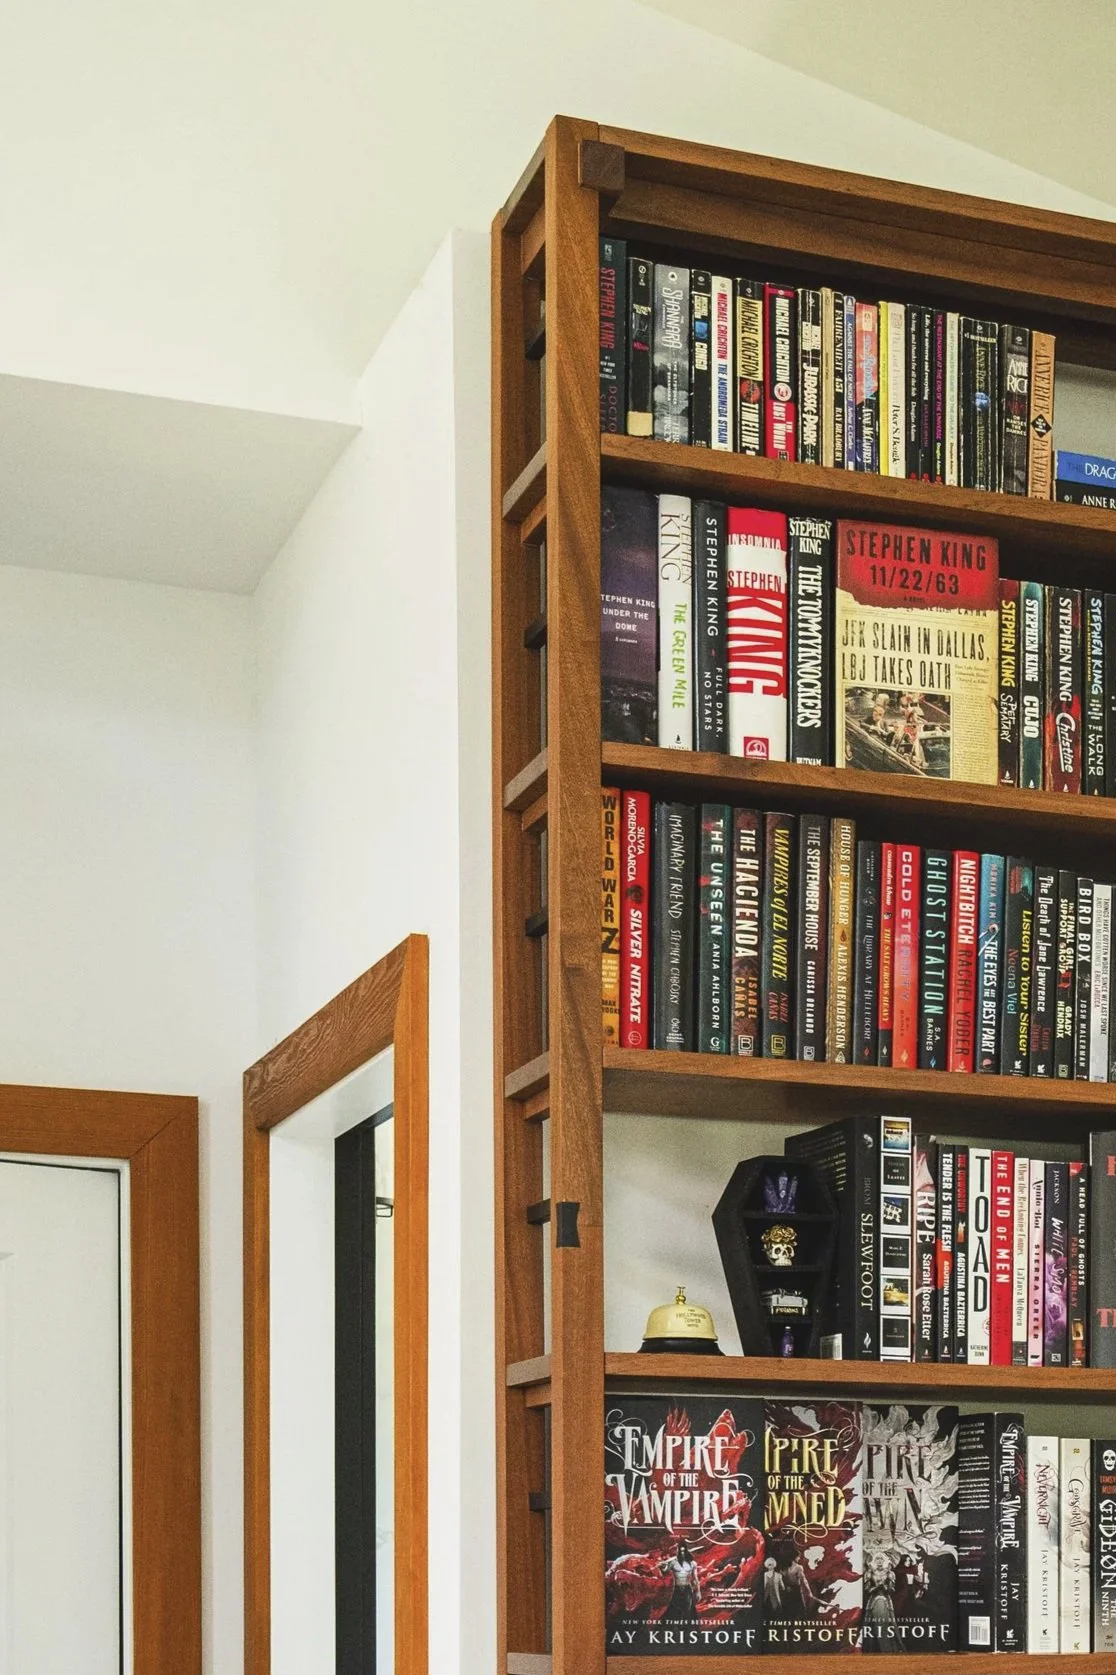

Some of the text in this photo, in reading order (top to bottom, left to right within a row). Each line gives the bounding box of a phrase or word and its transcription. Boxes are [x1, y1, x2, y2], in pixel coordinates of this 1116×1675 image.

[695, 343, 708, 371] CONGO
[717, 292, 728, 444] MICHAEL CRICHTON THE ANDROMEDA STRAIN
[803, 362, 818, 447] JURASSIC PARK
[846, 530, 988, 570] STEPHEN KING
[869, 565, 959, 595] 11/22/63
[671, 603, 687, 709] THE GREEN MILE
[797, 565, 822, 729] THE TOMMYKNOCKERS
[841, 656, 866, 680] LBJ
[874, 656, 913, 686] TAKES
[919, 660, 952, 690] OATH
[842, 620, 866, 648] JFK
[873, 622, 910, 650] SLAIN
[917, 626, 931, 652] IN
[735, 829, 758, 958] THE HACIENDA
[901, 851, 912, 902] COLD
[958, 858, 976, 946] NIGHTBITCH
[710, 819, 723, 1029] THE UNSEEN ANIA AHLBORN
[924, 858, 947, 1015] GHOST STATION
[1078, 887, 1092, 963] BIRD BOX
[627, 908, 642, 1024] SILVER NITRATE
[974, 1155, 990, 1313] TOAD
[996, 1156, 1011, 1284] THE END OF MEN
[860, 1213, 874, 1310] SLEWFOOT
[922, 1253, 932, 1341] Sarah Rose Etter
[614, 1426, 739, 1478] EMPIRE
[663, 1473, 698, 1487] OF THE
[606, 1473, 750, 1533] VAMPIRE
[1000, 1564, 1008, 1620] KRISTOFF
[1011, 1583, 1019, 1600] JAY
[650, 1629, 755, 1648] KRISTOFF
